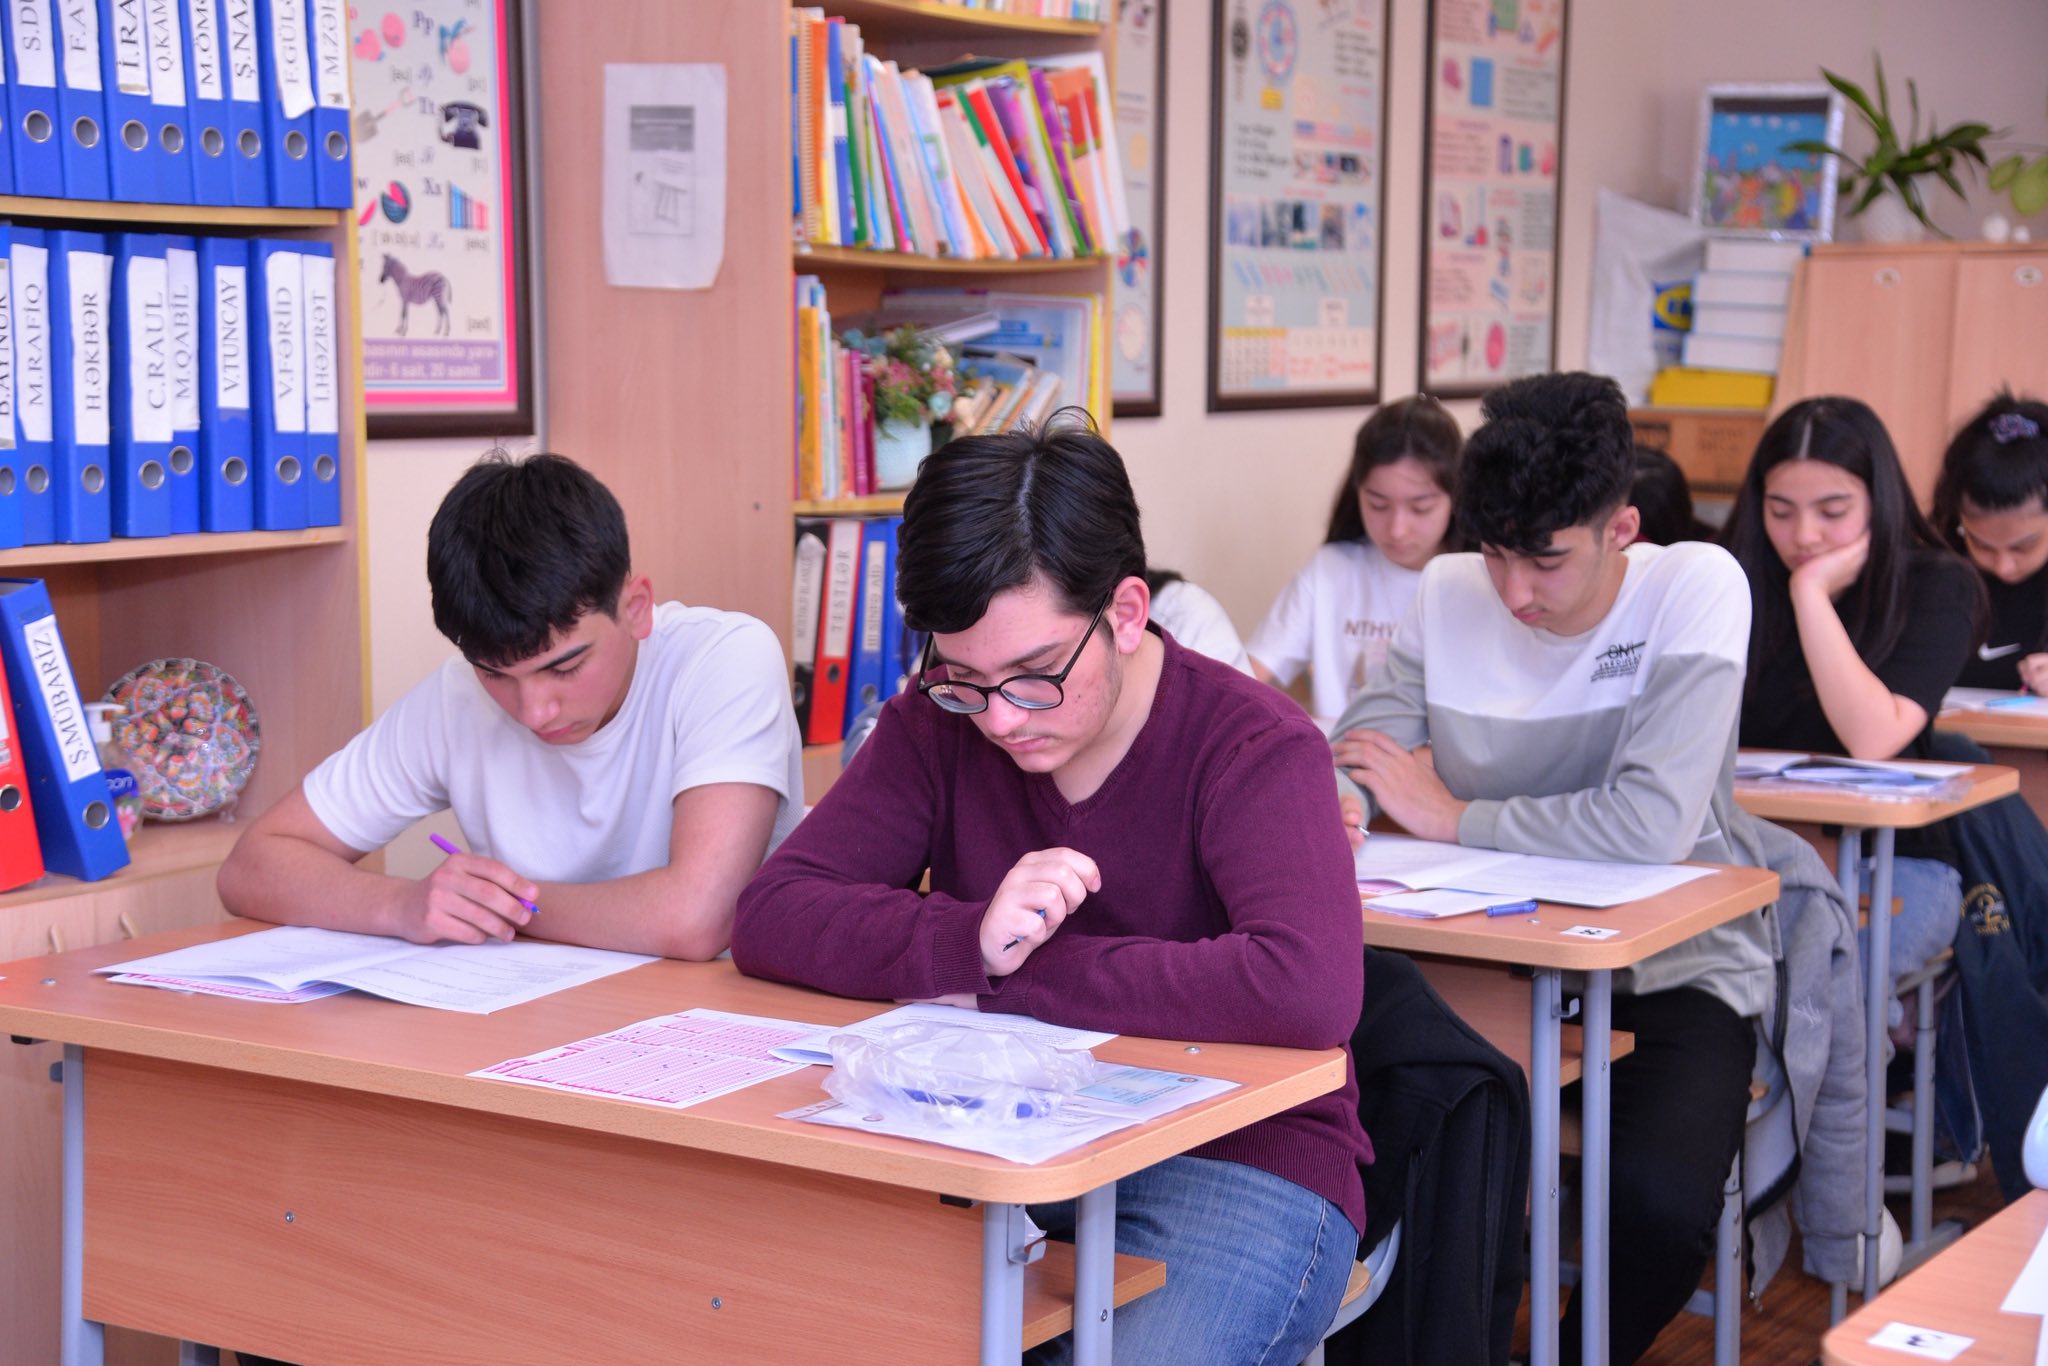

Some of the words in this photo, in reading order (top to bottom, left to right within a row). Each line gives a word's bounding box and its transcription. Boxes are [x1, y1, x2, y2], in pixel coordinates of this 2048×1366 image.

[21, 0, 42, 52] S.D
[66, 0, 87, 53] F.A
[194, 0, 215, 86] M.ÖM
[22, 283, 44, 406] M.RAFİQ
[83, 292, 101, 411] H.ƏKBƏR
[145, 291, 165, 410] C.RAUL
[171, 284, 192, 400] M.QABİL
[221, 280, 240, 393] V.TUNCAY
